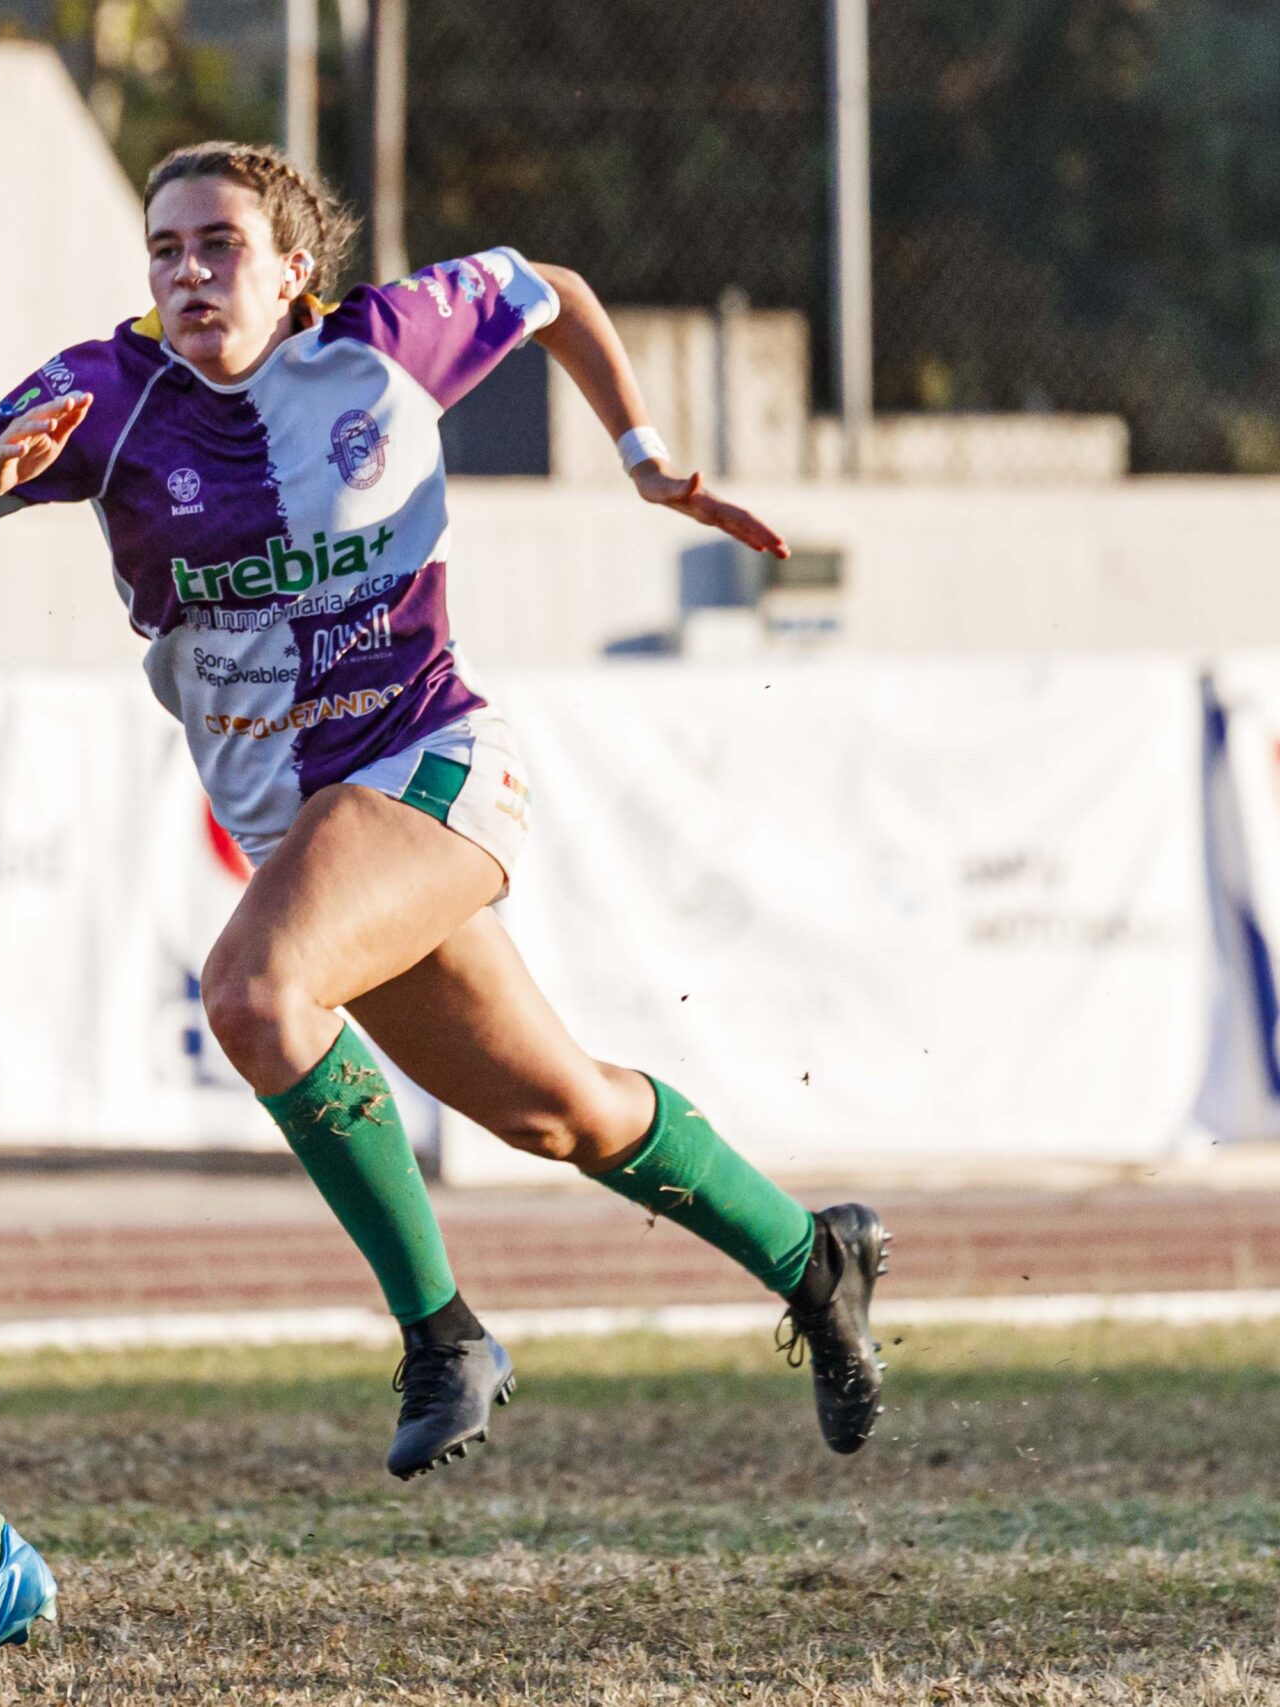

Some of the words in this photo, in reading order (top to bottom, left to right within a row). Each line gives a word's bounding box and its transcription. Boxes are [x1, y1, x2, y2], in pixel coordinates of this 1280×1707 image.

[172, 525, 394, 603] trebia+
[193, 647, 237, 672] Soria
[196, 666, 299, 687] Renovables
